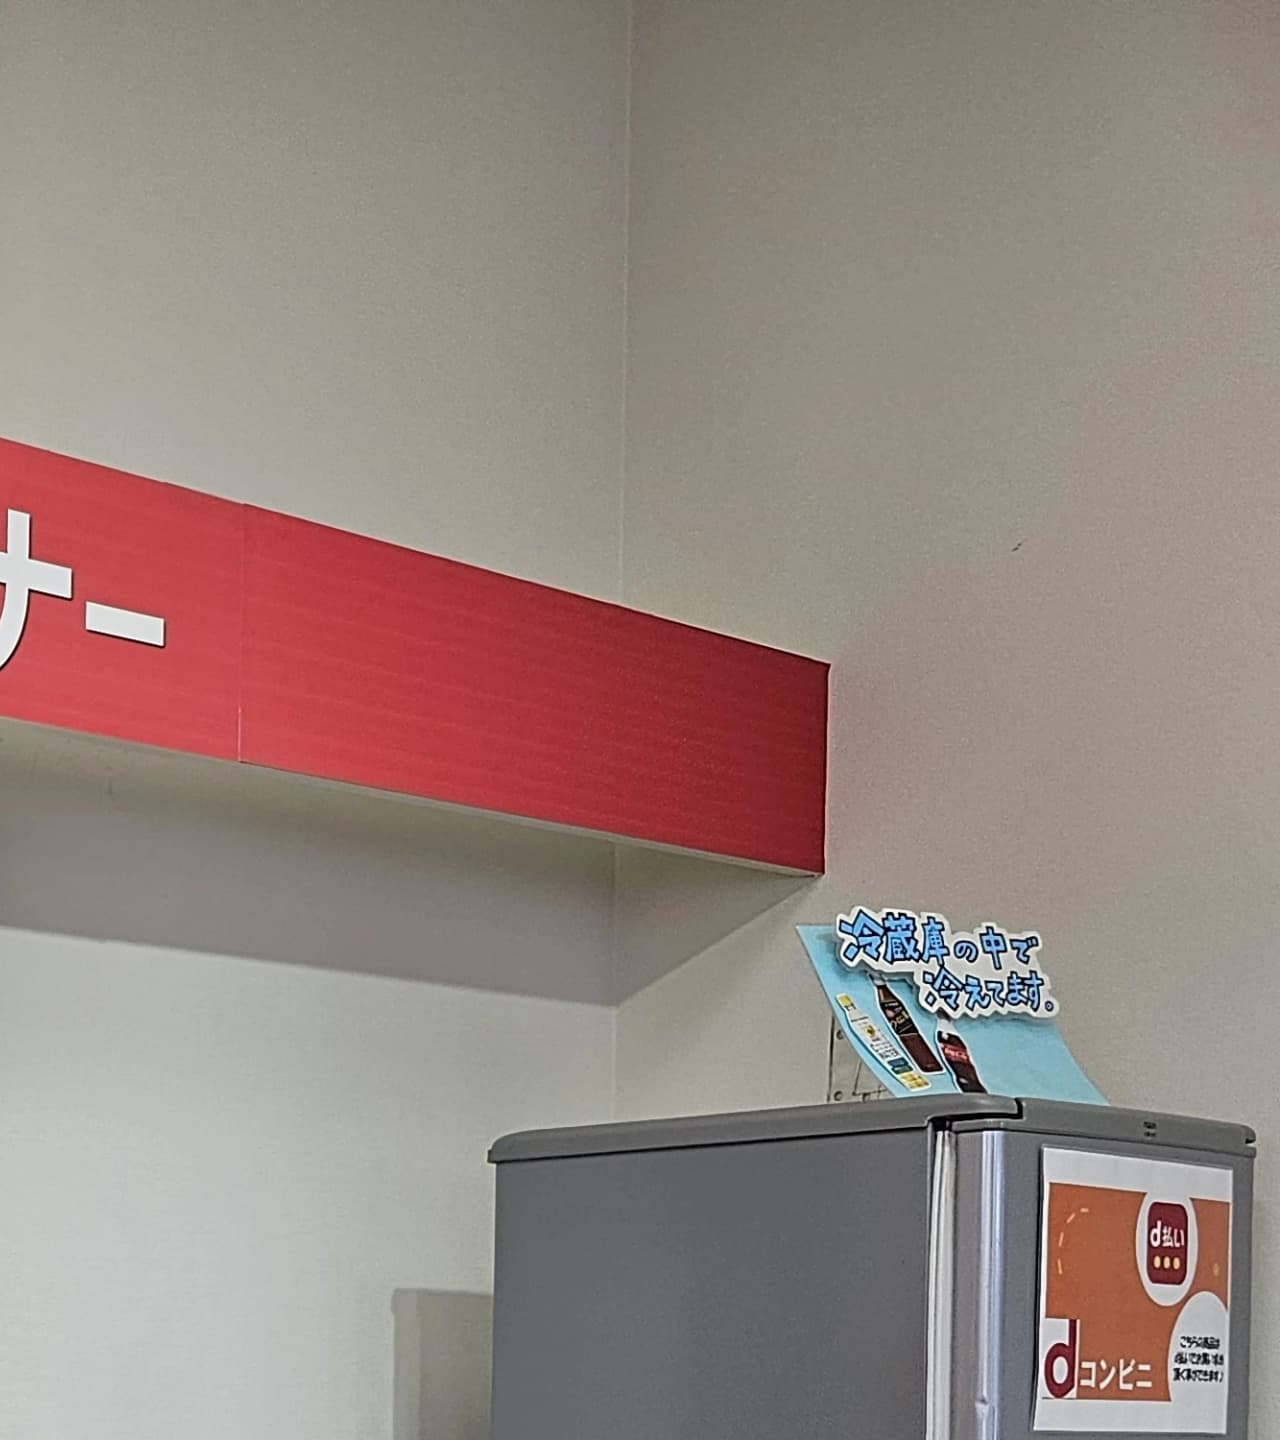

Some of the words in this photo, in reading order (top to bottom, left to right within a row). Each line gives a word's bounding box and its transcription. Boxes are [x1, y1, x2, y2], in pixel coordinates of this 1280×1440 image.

[840, 909, 1040, 970] 冷蔵庫の中で
[921, 968, 1056, 1014] 冷えてます。
[1149, 1222, 1186, 1250] d払い
